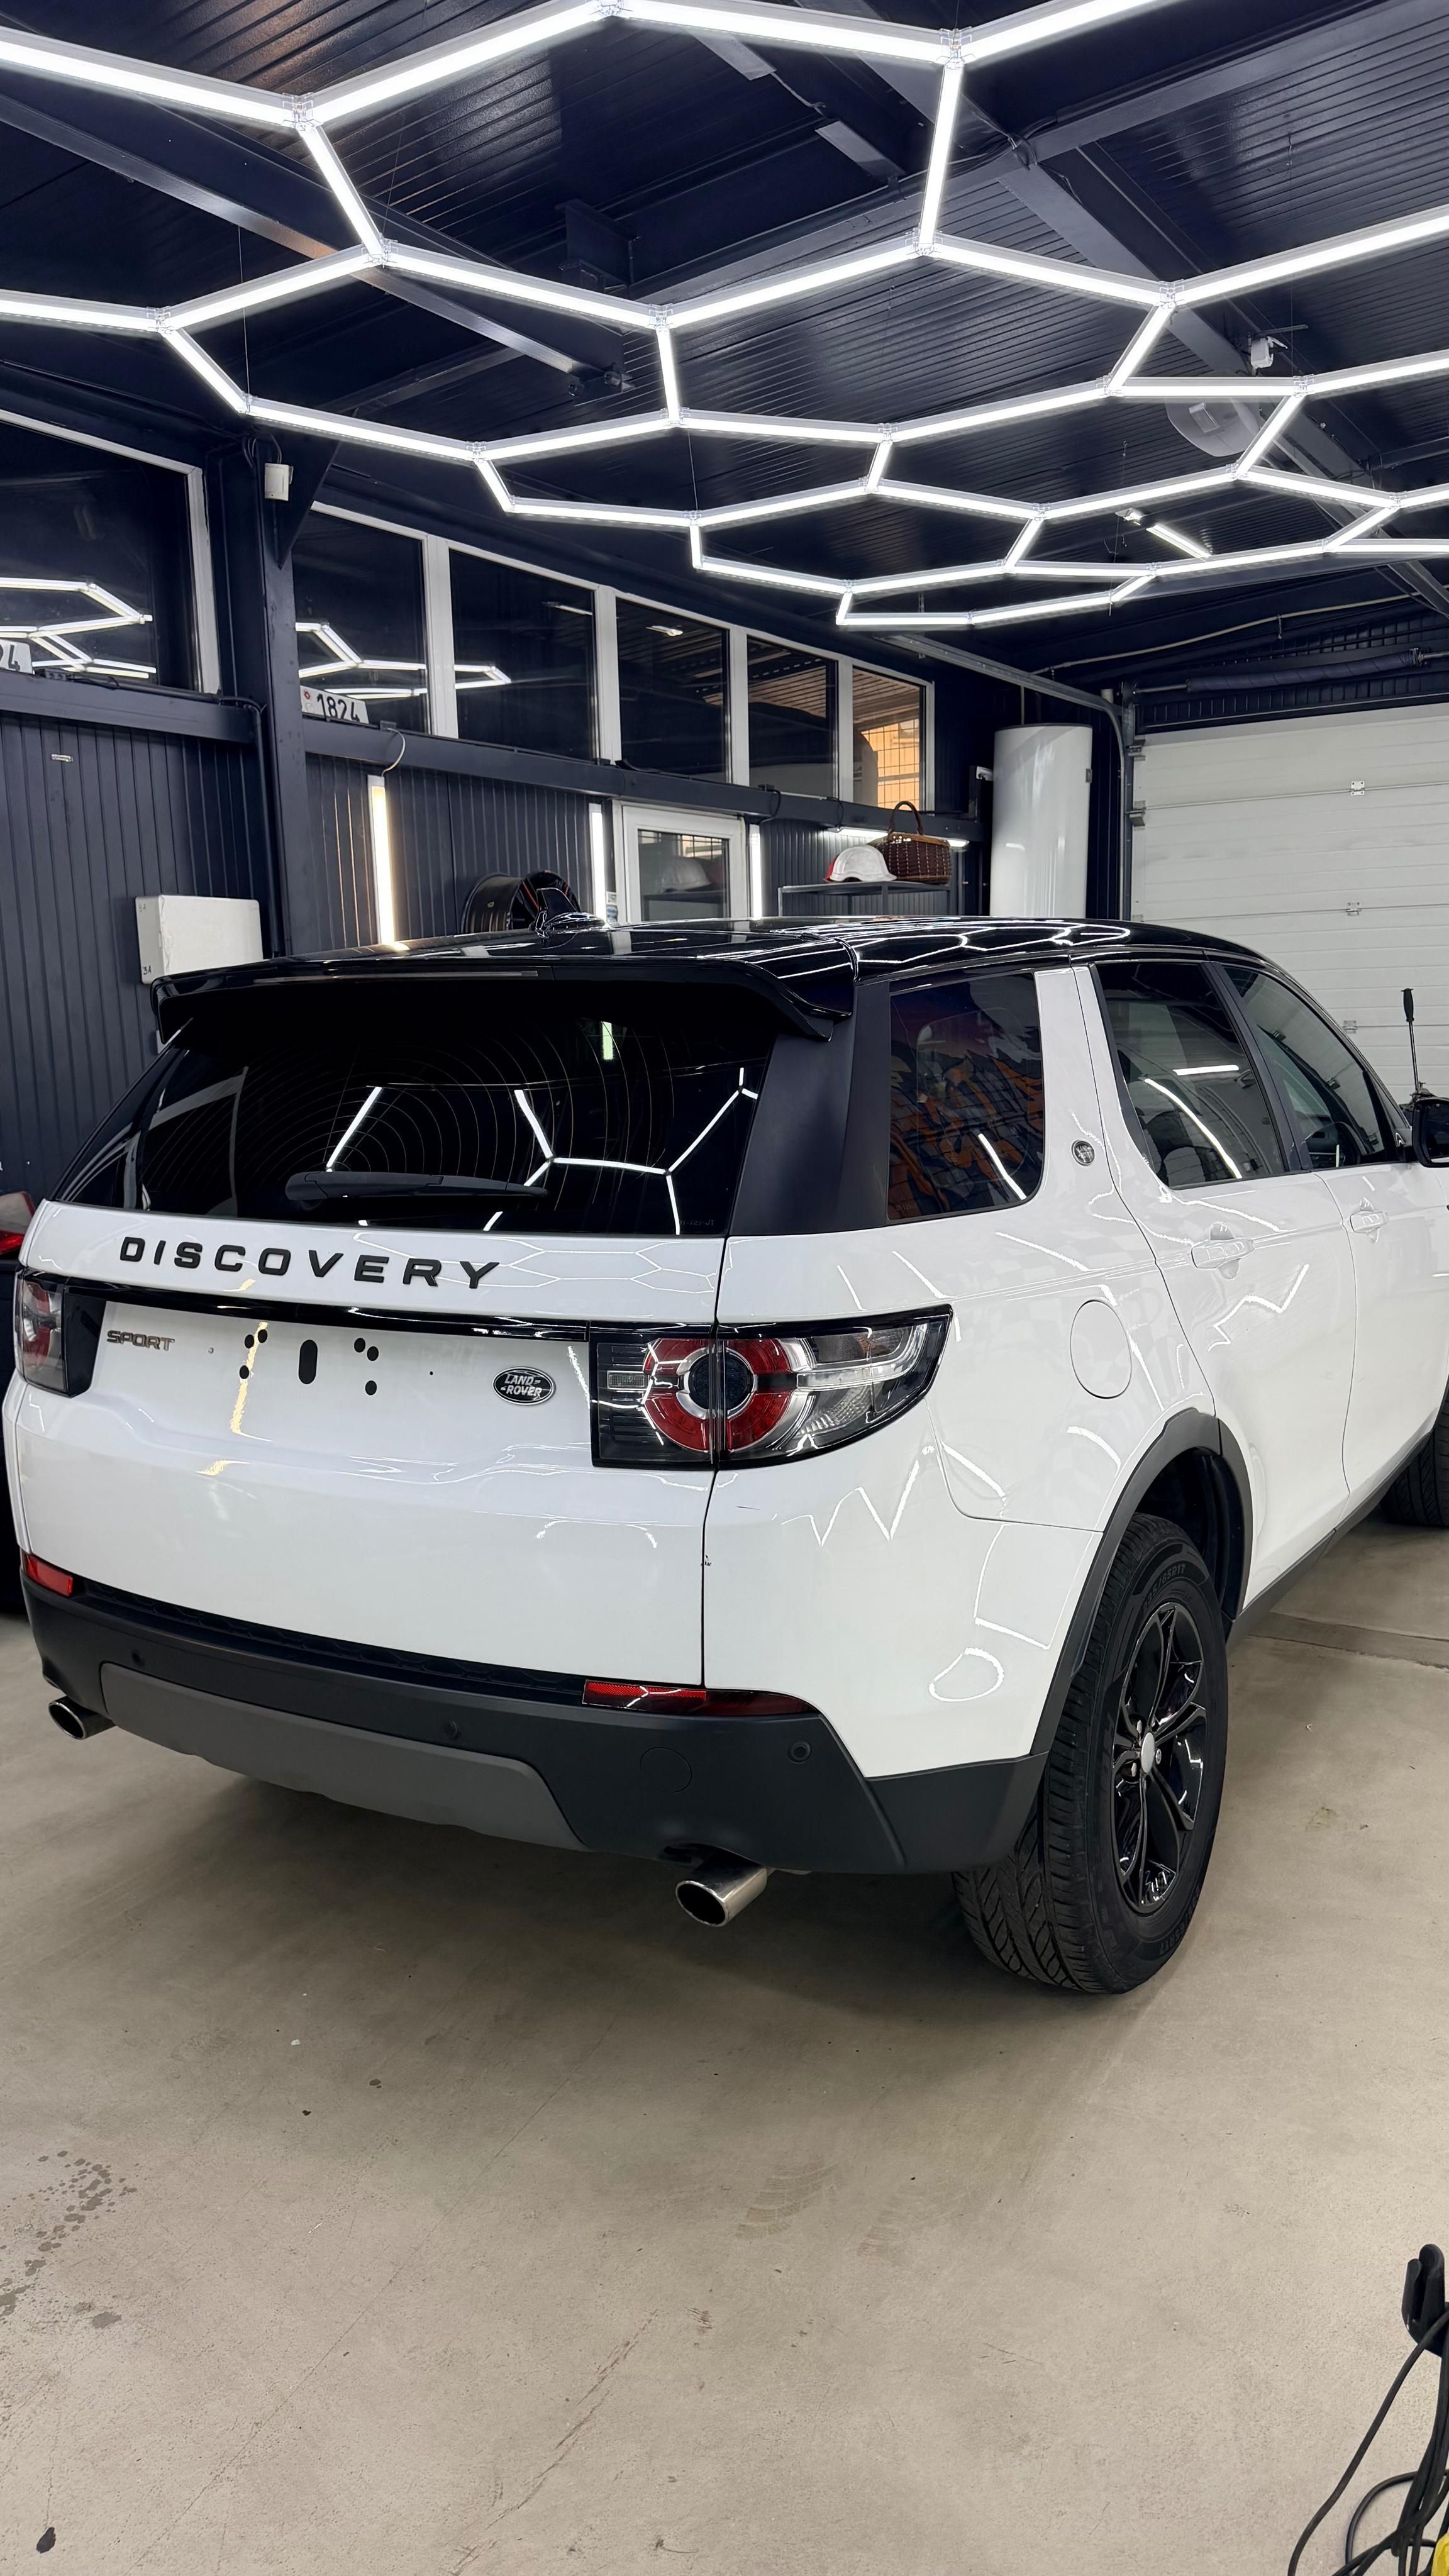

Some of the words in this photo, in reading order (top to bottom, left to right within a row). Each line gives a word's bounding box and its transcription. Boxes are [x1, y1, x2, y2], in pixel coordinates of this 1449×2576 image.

[317, 694, 360, 722] 1824
[119, 1236, 500, 1290] DISCOVERY
[106, 1330, 175, 1352] SPORT
[504, 1374, 535, 1385] LAND
[506, 1385, 542, 1397] ROVER
